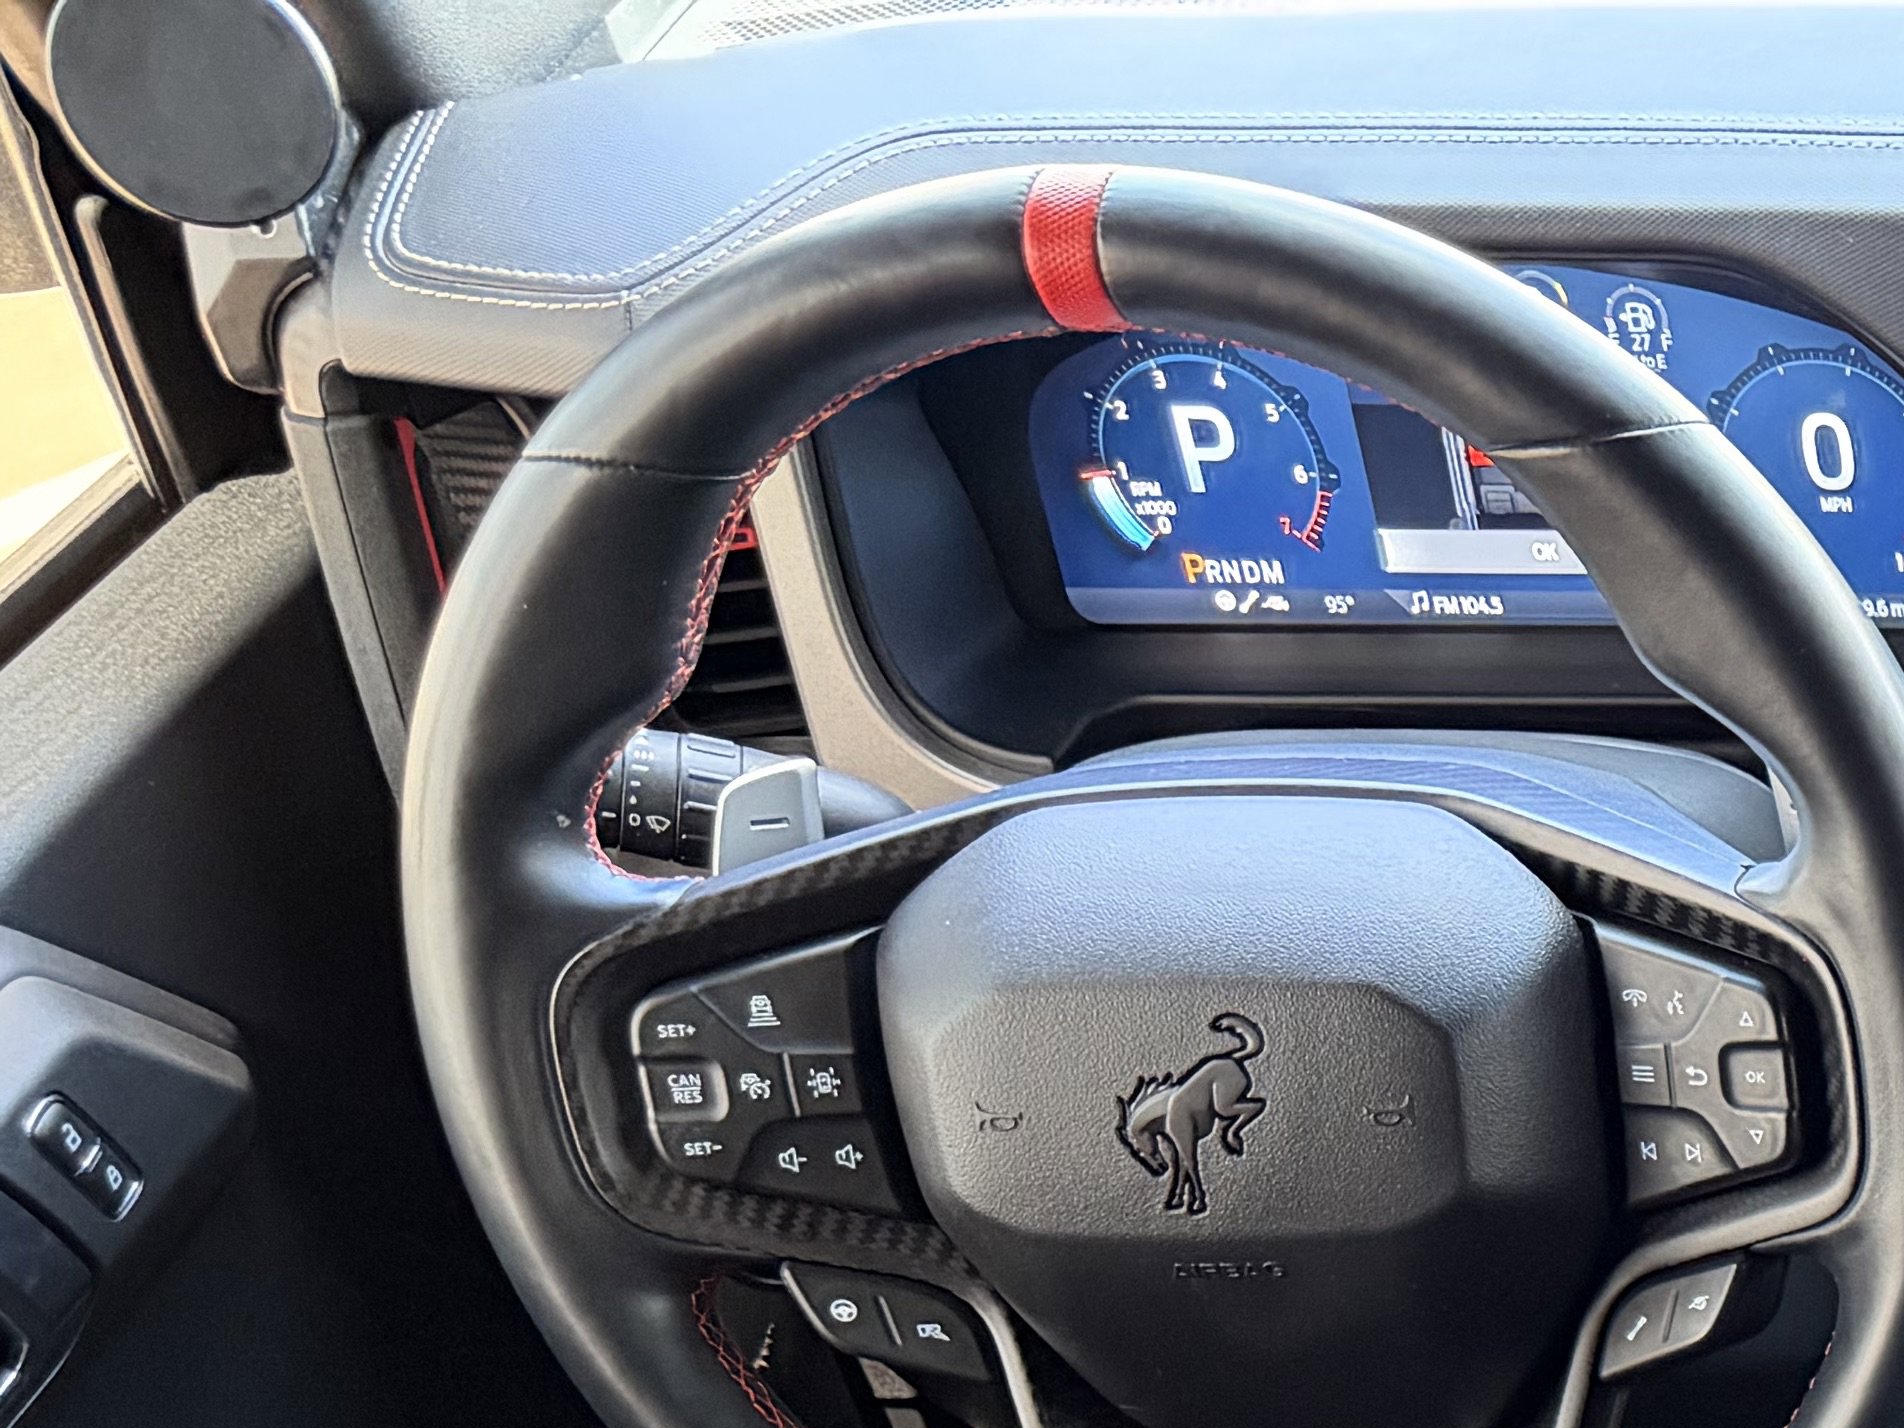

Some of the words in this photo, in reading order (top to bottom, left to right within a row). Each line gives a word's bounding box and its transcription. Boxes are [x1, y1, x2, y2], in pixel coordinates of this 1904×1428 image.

[1630, 334, 1650, 351] 27
[1151, 369, 1167, 389] 3
[1213, 369, 1227, 389] 4
[1113, 401, 1130, 421] 2
[1264, 403, 1281, 423] 5
[1170, 404, 1237, 493] P
[1801, 411, 1856, 491] 0
[1116, 461, 1129, 480] 1
[1293, 465, 1309, 484] 6
[1130, 481, 1163, 497] RPM
[1820, 496, 1853, 513] MPH
[1156, 516, 1173, 535] 0
[1279, 516, 1291, 535] 7
[1531, 541, 1560, 561] OK
[1323, 595, 1355, 614] 95°
[667, 1073, 702, 1089] CAN
[1745, 1070, 1766, 1084] OK
[673, 1089, 704, 1105] RES
